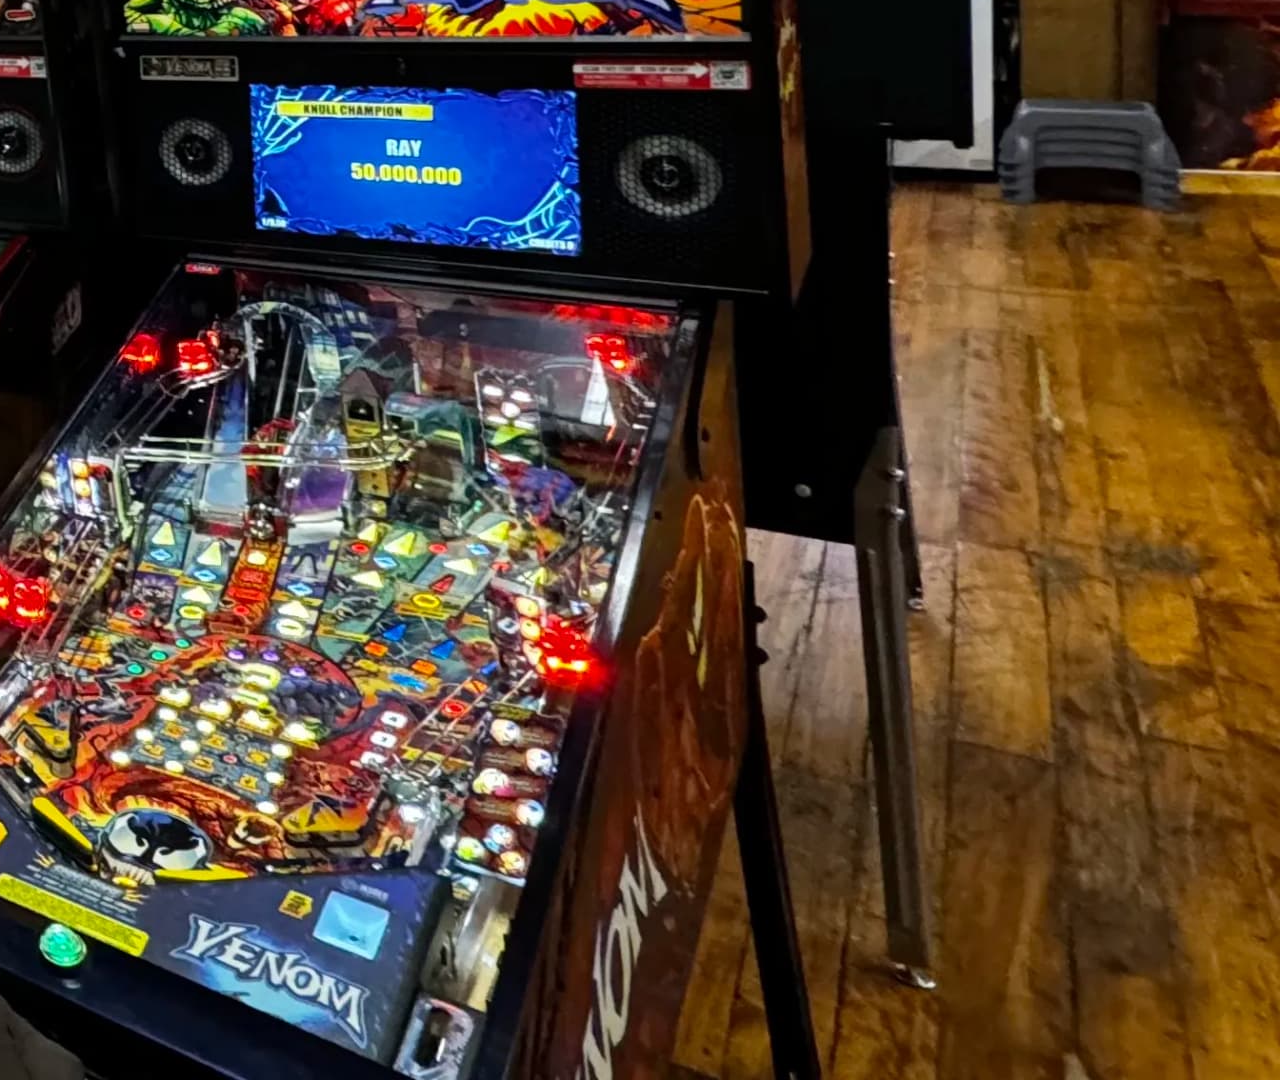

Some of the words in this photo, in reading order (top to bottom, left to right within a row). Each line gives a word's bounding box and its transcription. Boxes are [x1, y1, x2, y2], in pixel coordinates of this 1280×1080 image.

[302, 104, 338, 116] KNULL
[340, 105, 404, 117] CHAMPION
[385, 138, 422, 158] RAY
[350, 161, 463, 186] 50,000,000
[185, 919, 365, 1034] VENOM
